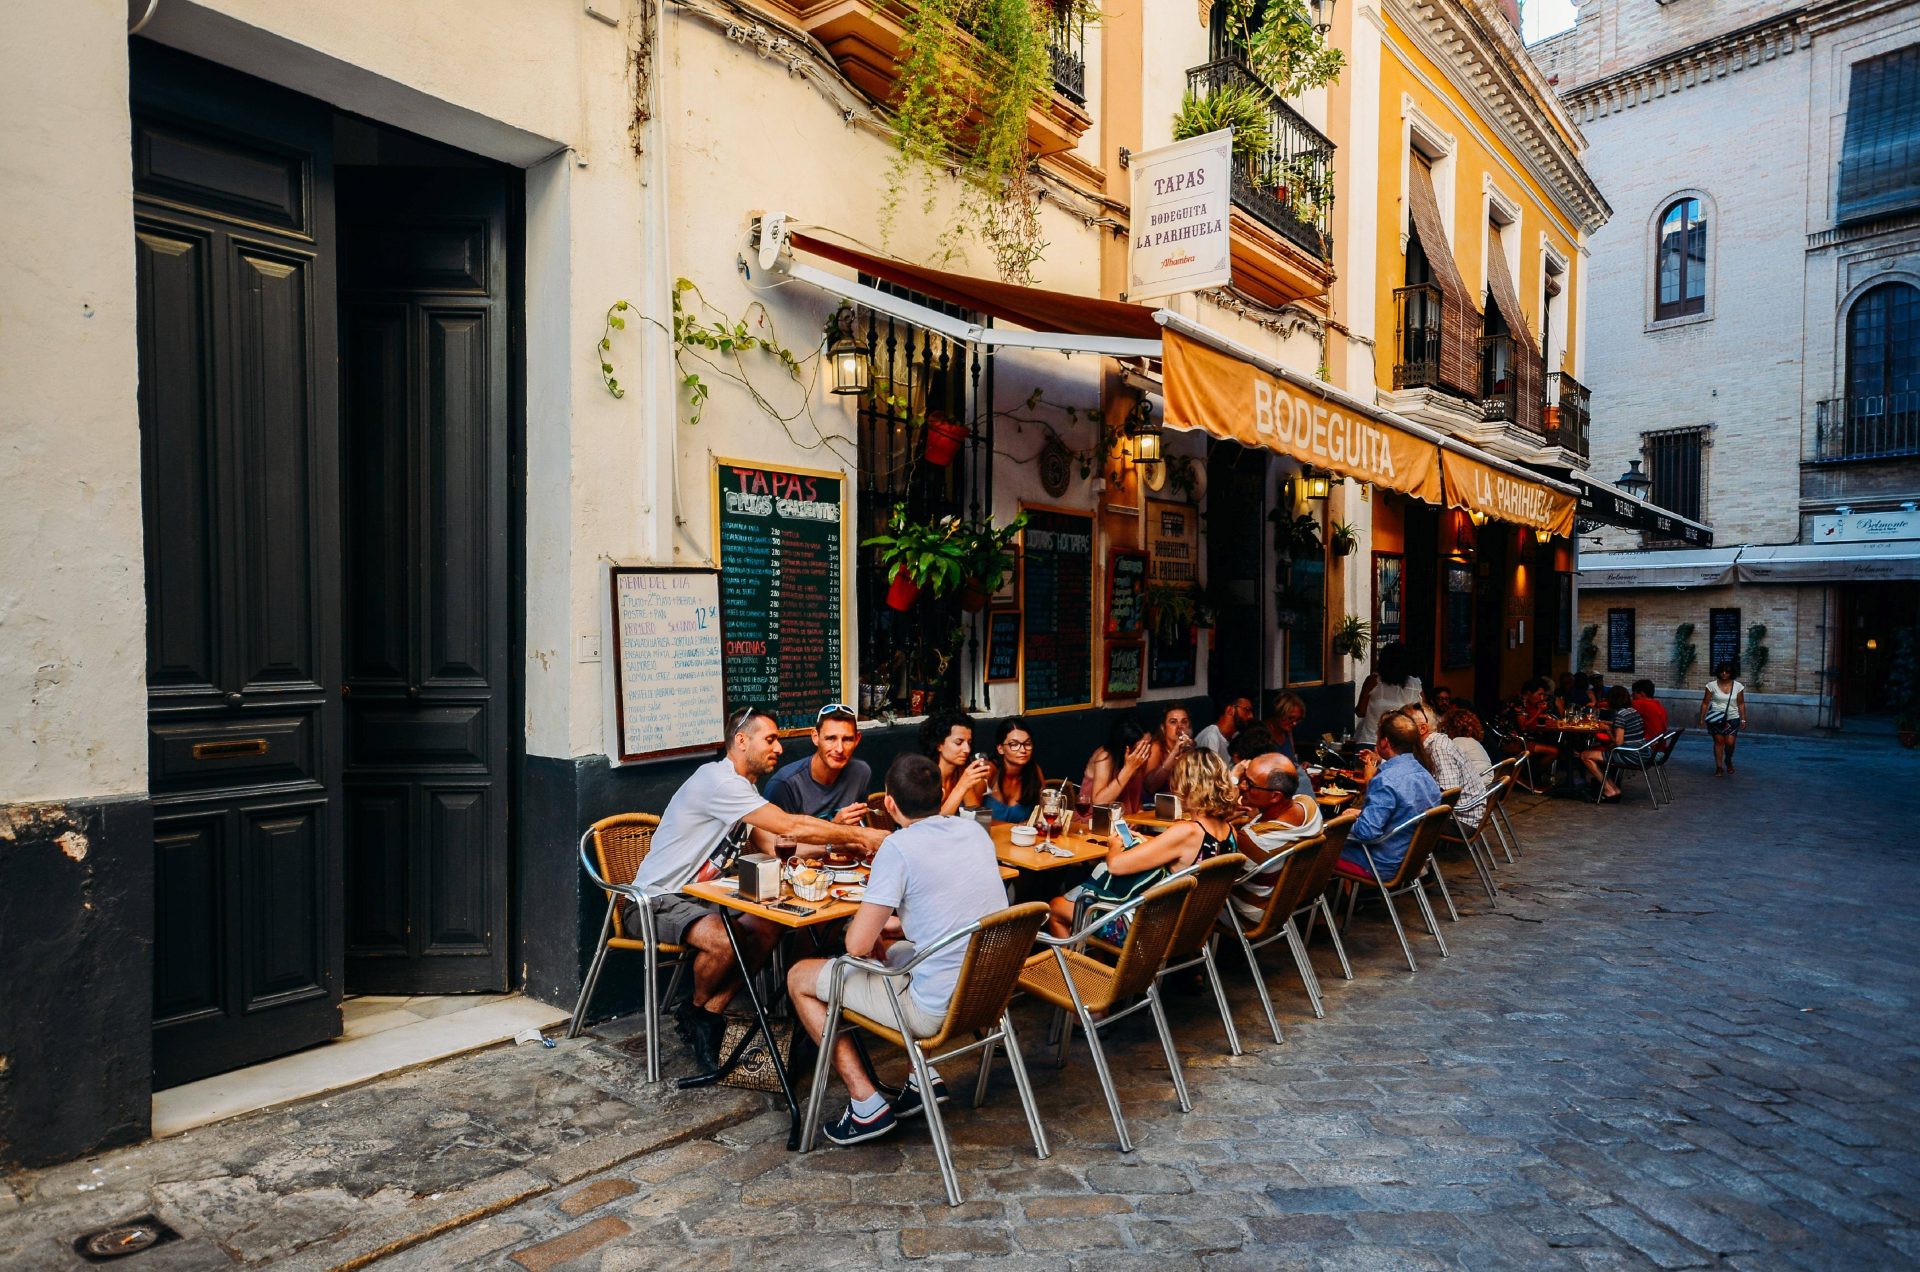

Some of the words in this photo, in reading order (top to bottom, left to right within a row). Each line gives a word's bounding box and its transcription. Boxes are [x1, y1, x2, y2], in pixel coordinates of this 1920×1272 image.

[1154, 168, 1205, 196] TAPAS
[1150, 203, 1207, 226] BODEGUITA
[1136, 234, 1152, 249] LA
[1155, 219, 1222, 246] PARIHUELA
[1160, 254, 1197, 269] Alhambra
[1254, 379, 1395, 477] BODEGUITA
[732, 467, 817, 501] TAPAS
[726, 491, 773, 514] FRIAS
[1474, 468, 1493, 507] LA
[1496, 475, 1554, 524] PARIHUELA
[1856, 518, 1908, 529] Belmonte
[649, 577, 668, 590] DEL
[727, 641, 767, 655] CHACINAS
